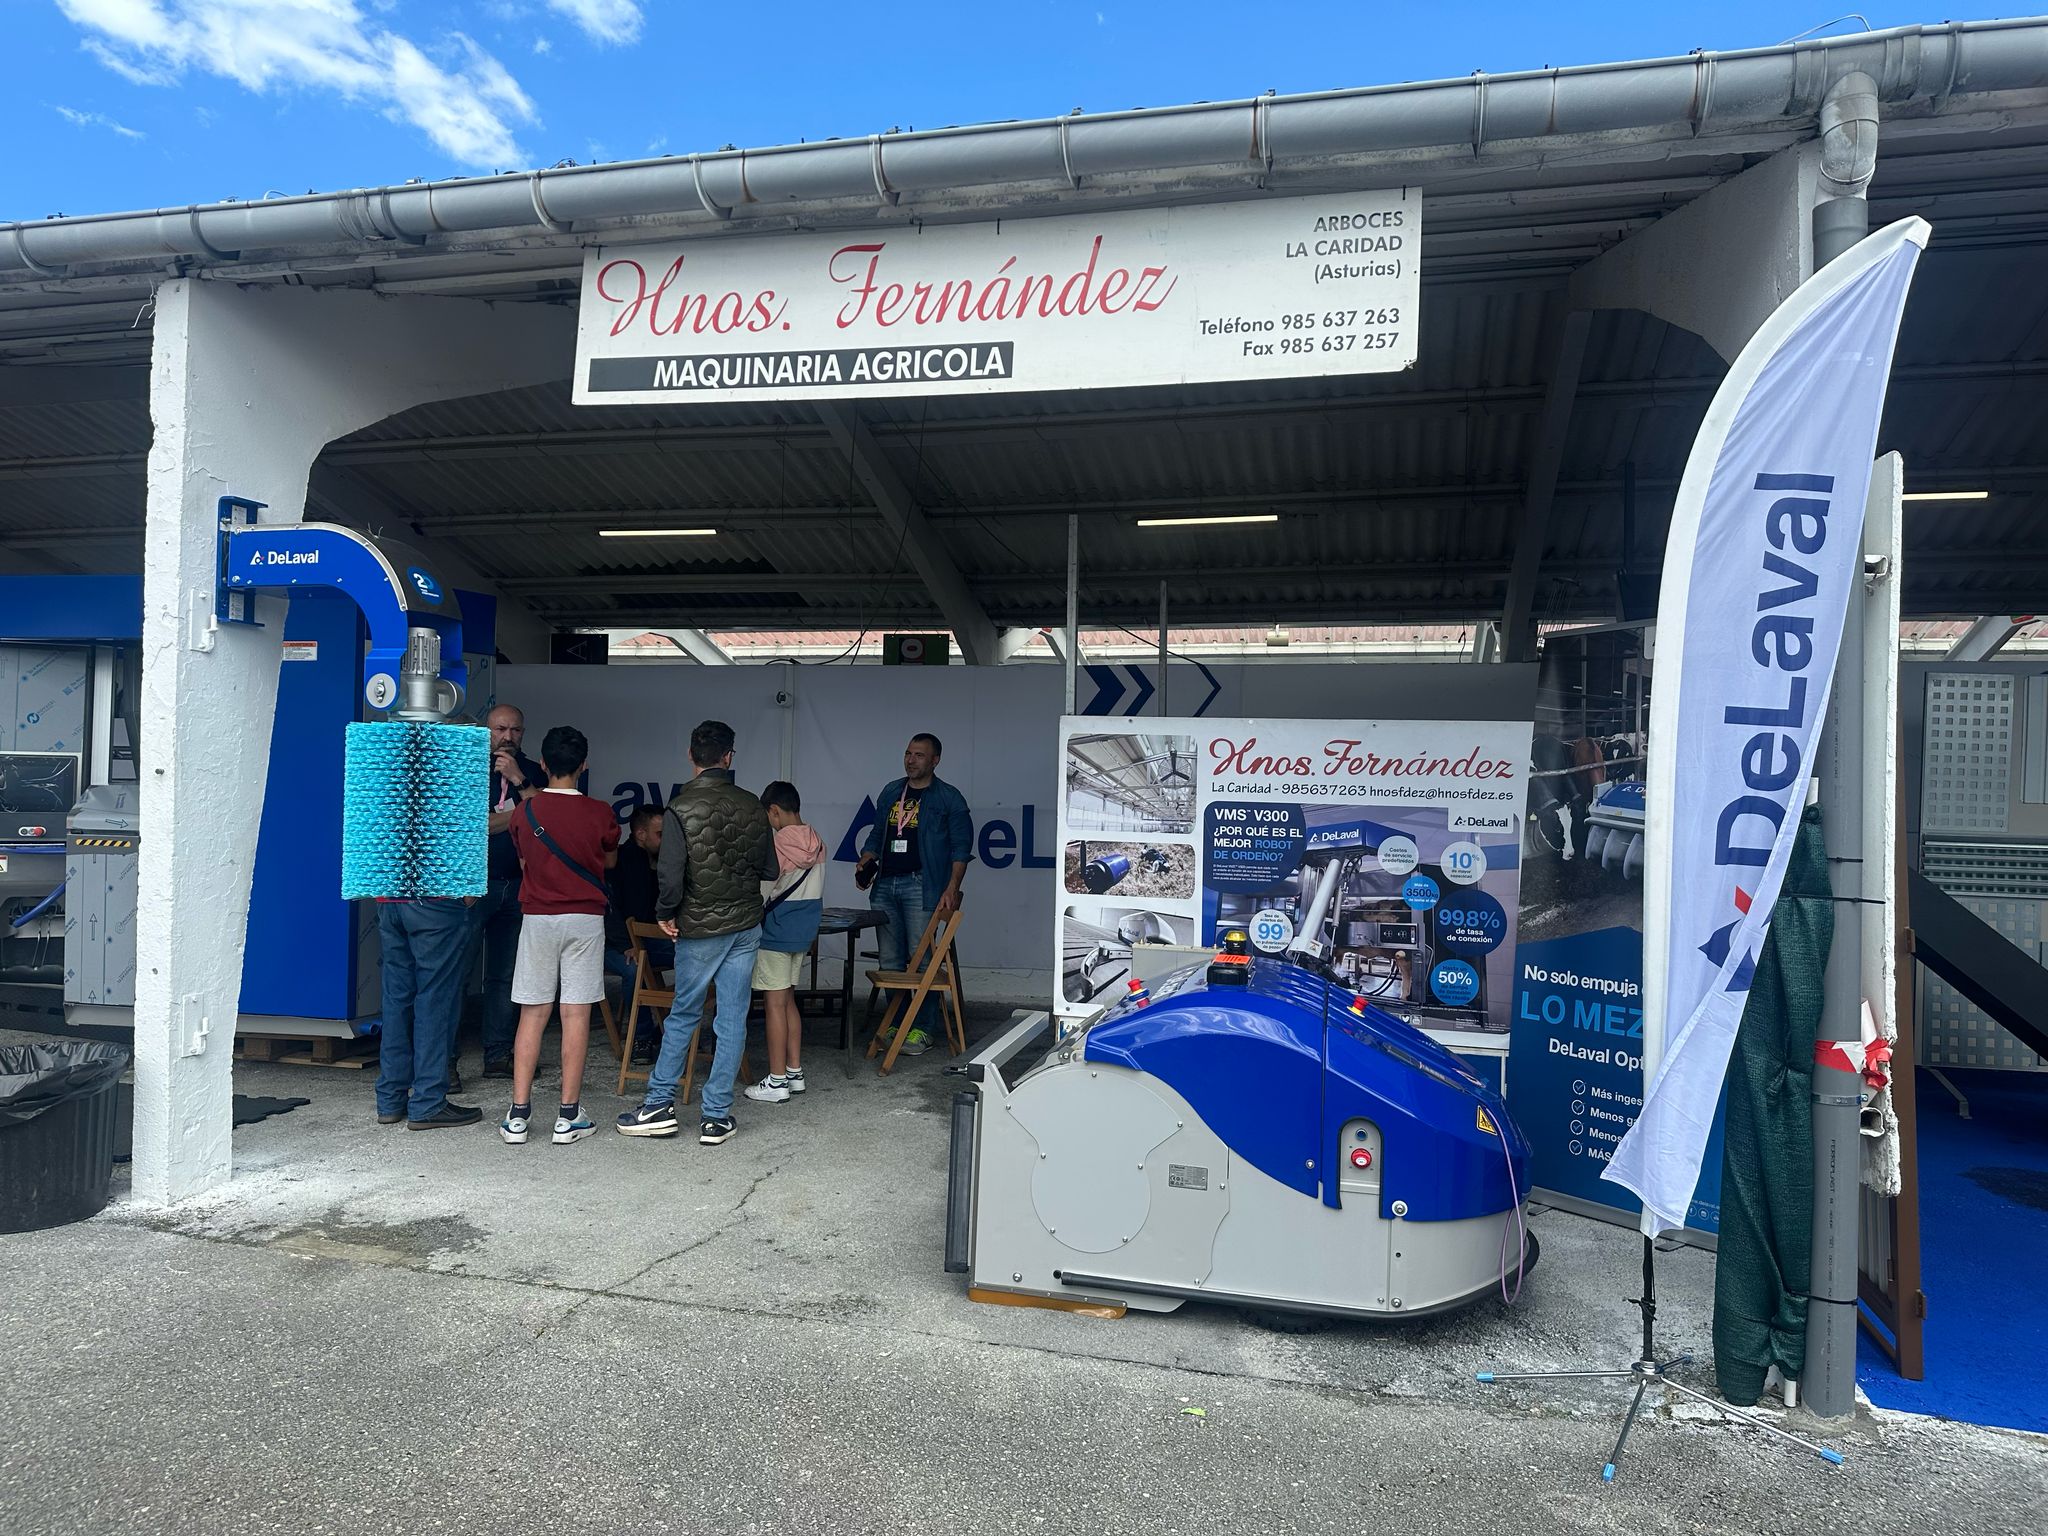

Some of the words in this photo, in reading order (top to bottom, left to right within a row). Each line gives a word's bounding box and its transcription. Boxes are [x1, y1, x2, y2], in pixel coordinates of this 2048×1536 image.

[1314, 211, 1404, 233] ARBOCES
[1286, 242, 1309, 258] LA
[1315, 236, 1403, 257] CARIDAD
[1315, 259, 1401, 284] (Asturias)
[597, 255, 790, 337] Hnos.
[829, 235, 1178, 329] Fernández
[1200, 318, 1275, 335] Teléfono
[1281, 313, 1316, 331] 985
[1322, 310, 1358, 328] 637
[1364, 308, 1400, 326] 263
[1243, 340, 1274, 356] Fax
[1280, 337, 1315, 354] 985
[1321, 335, 1357, 351] 637
[1363, 332, 1400, 350] 257
[653, 353, 842, 388] MAQUINARIA
[849, 346, 1006, 381] AGRICOLA
[267, 549, 319, 565] DeLaval
[1714, 472, 1836, 867] DeLaval
[1209, 737, 1316, 776] Hnos.
[1323, 739, 1514, 779] Fernández
[1211, 782, 1225, 793] La
[1227, 782, 1271, 794] Caridad
[1281, 783, 1367, 796] 985637263
[1369, 785, 1514, 801] hnosfdez@hnosfdez.es
[1253, 809, 1289, 822] V300
[1467, 817, 1508, 827] DeLaval
[1213, 825, 1242, 837] ¿POR
[1245, 825, 1269, 837] QUÉ
[1272, 828, 1286, 837] ES
[1289, 828, 1303, 838] EL
[1322, 829, 1359, 841] DeLaval
[1213, 838, 1251, 848] MEJOR
[1255, 840, 1293, 850] ROBOT
[1213, 850, 1229, 859] DE
[1231, 850, 1284, 862] ORDEÑO?
[1439, 909, 1500, 929] 99,8%
[1438, 971, 1472, 985] 50%
[1525, 965, 1548, 982] No
[1550, 970, 1579, 987] solo
[1581, 976, 1638, 998] empuja
[1521, 991, 1566, 1025] LO
[1549, 1038, 1610, 1064] DeLaval
[1591, 1086, 1613, 1100] Más
[1590, 1107, 1624, 1123] Menos
[1589, 1127, 1623, 1143] Menos
